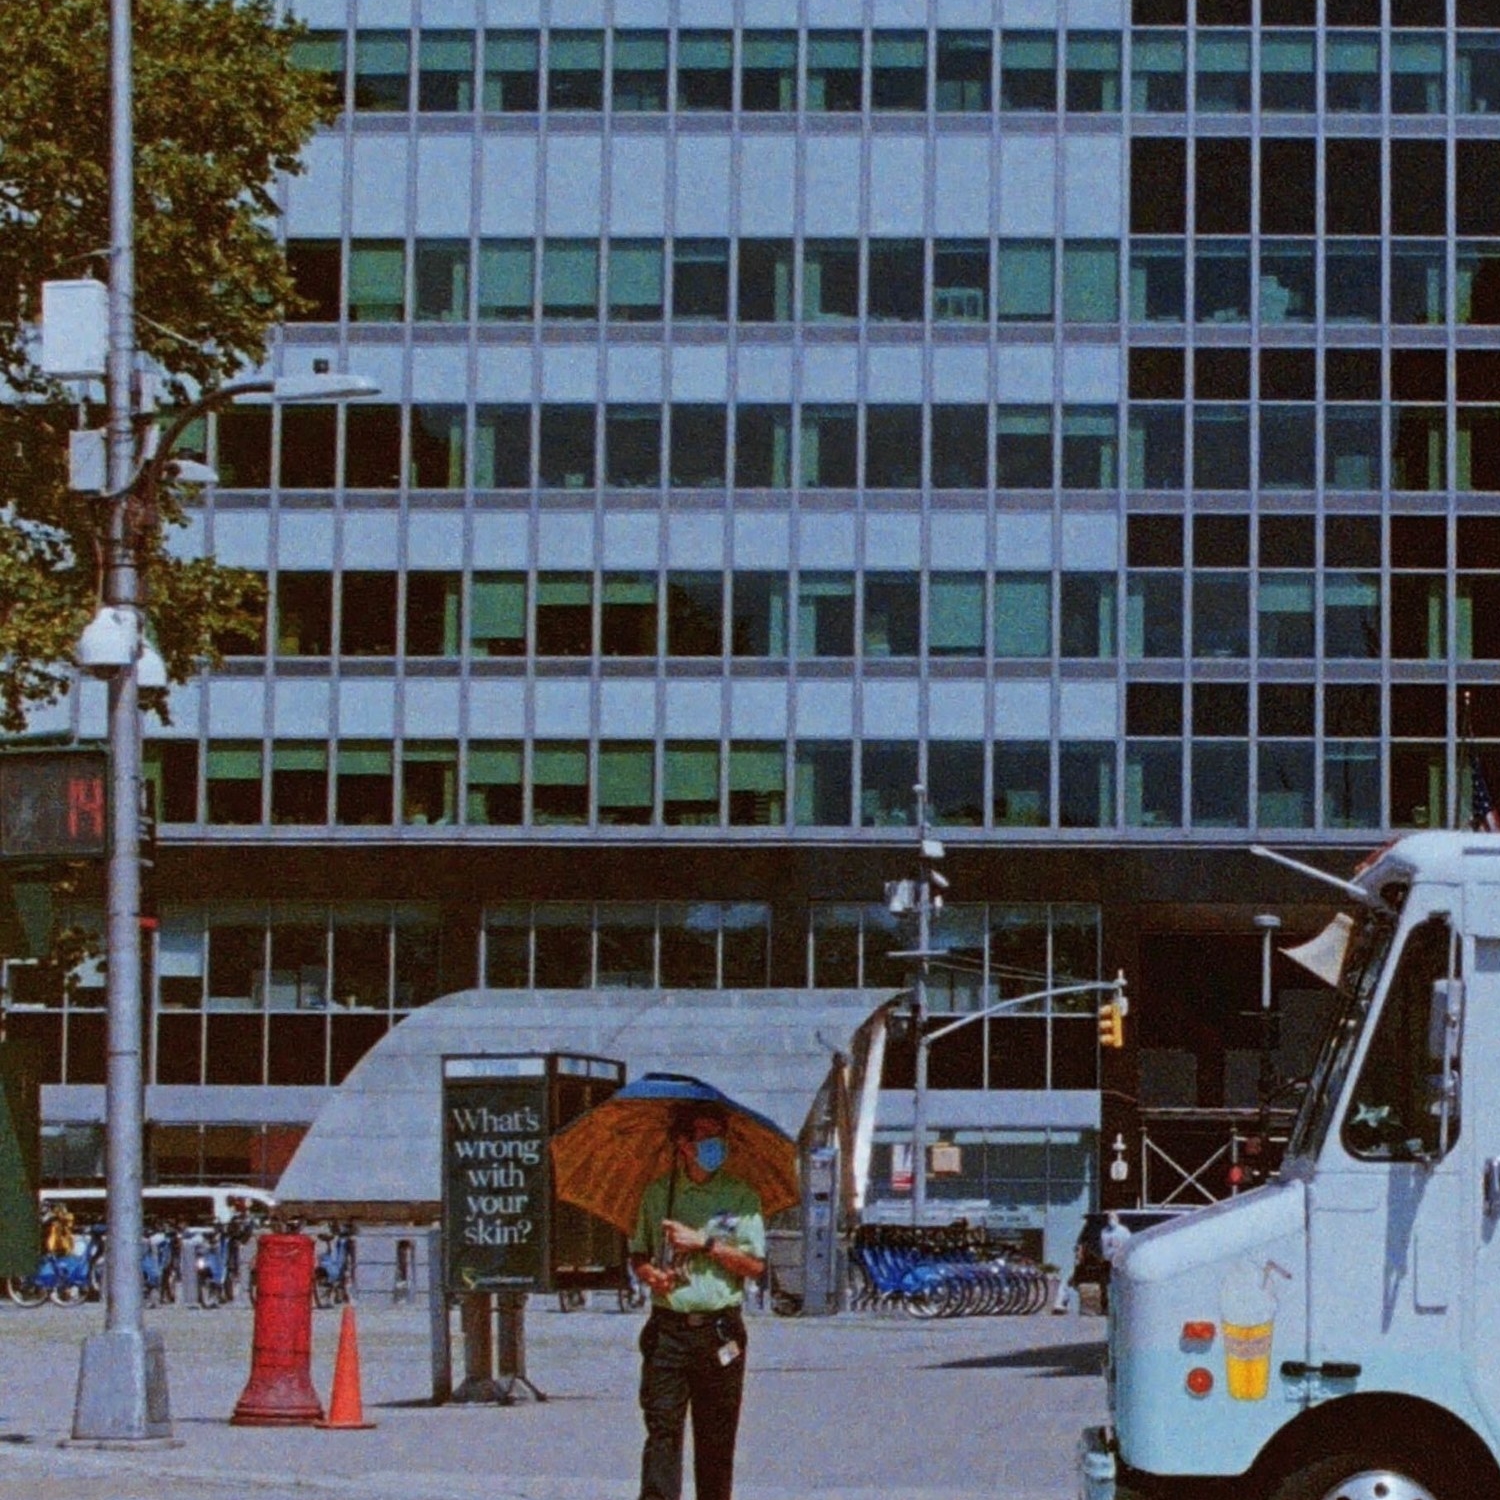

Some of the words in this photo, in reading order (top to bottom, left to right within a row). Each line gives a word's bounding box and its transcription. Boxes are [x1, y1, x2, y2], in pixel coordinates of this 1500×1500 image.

[453, 1106, 539, 1133] What's
[455, 1140, 540, 1164] wrong
[467, 1160, 526, 1188] with
[465, 1194, 529, 1222] your
[464, 1218, 532, 1245] skin?
